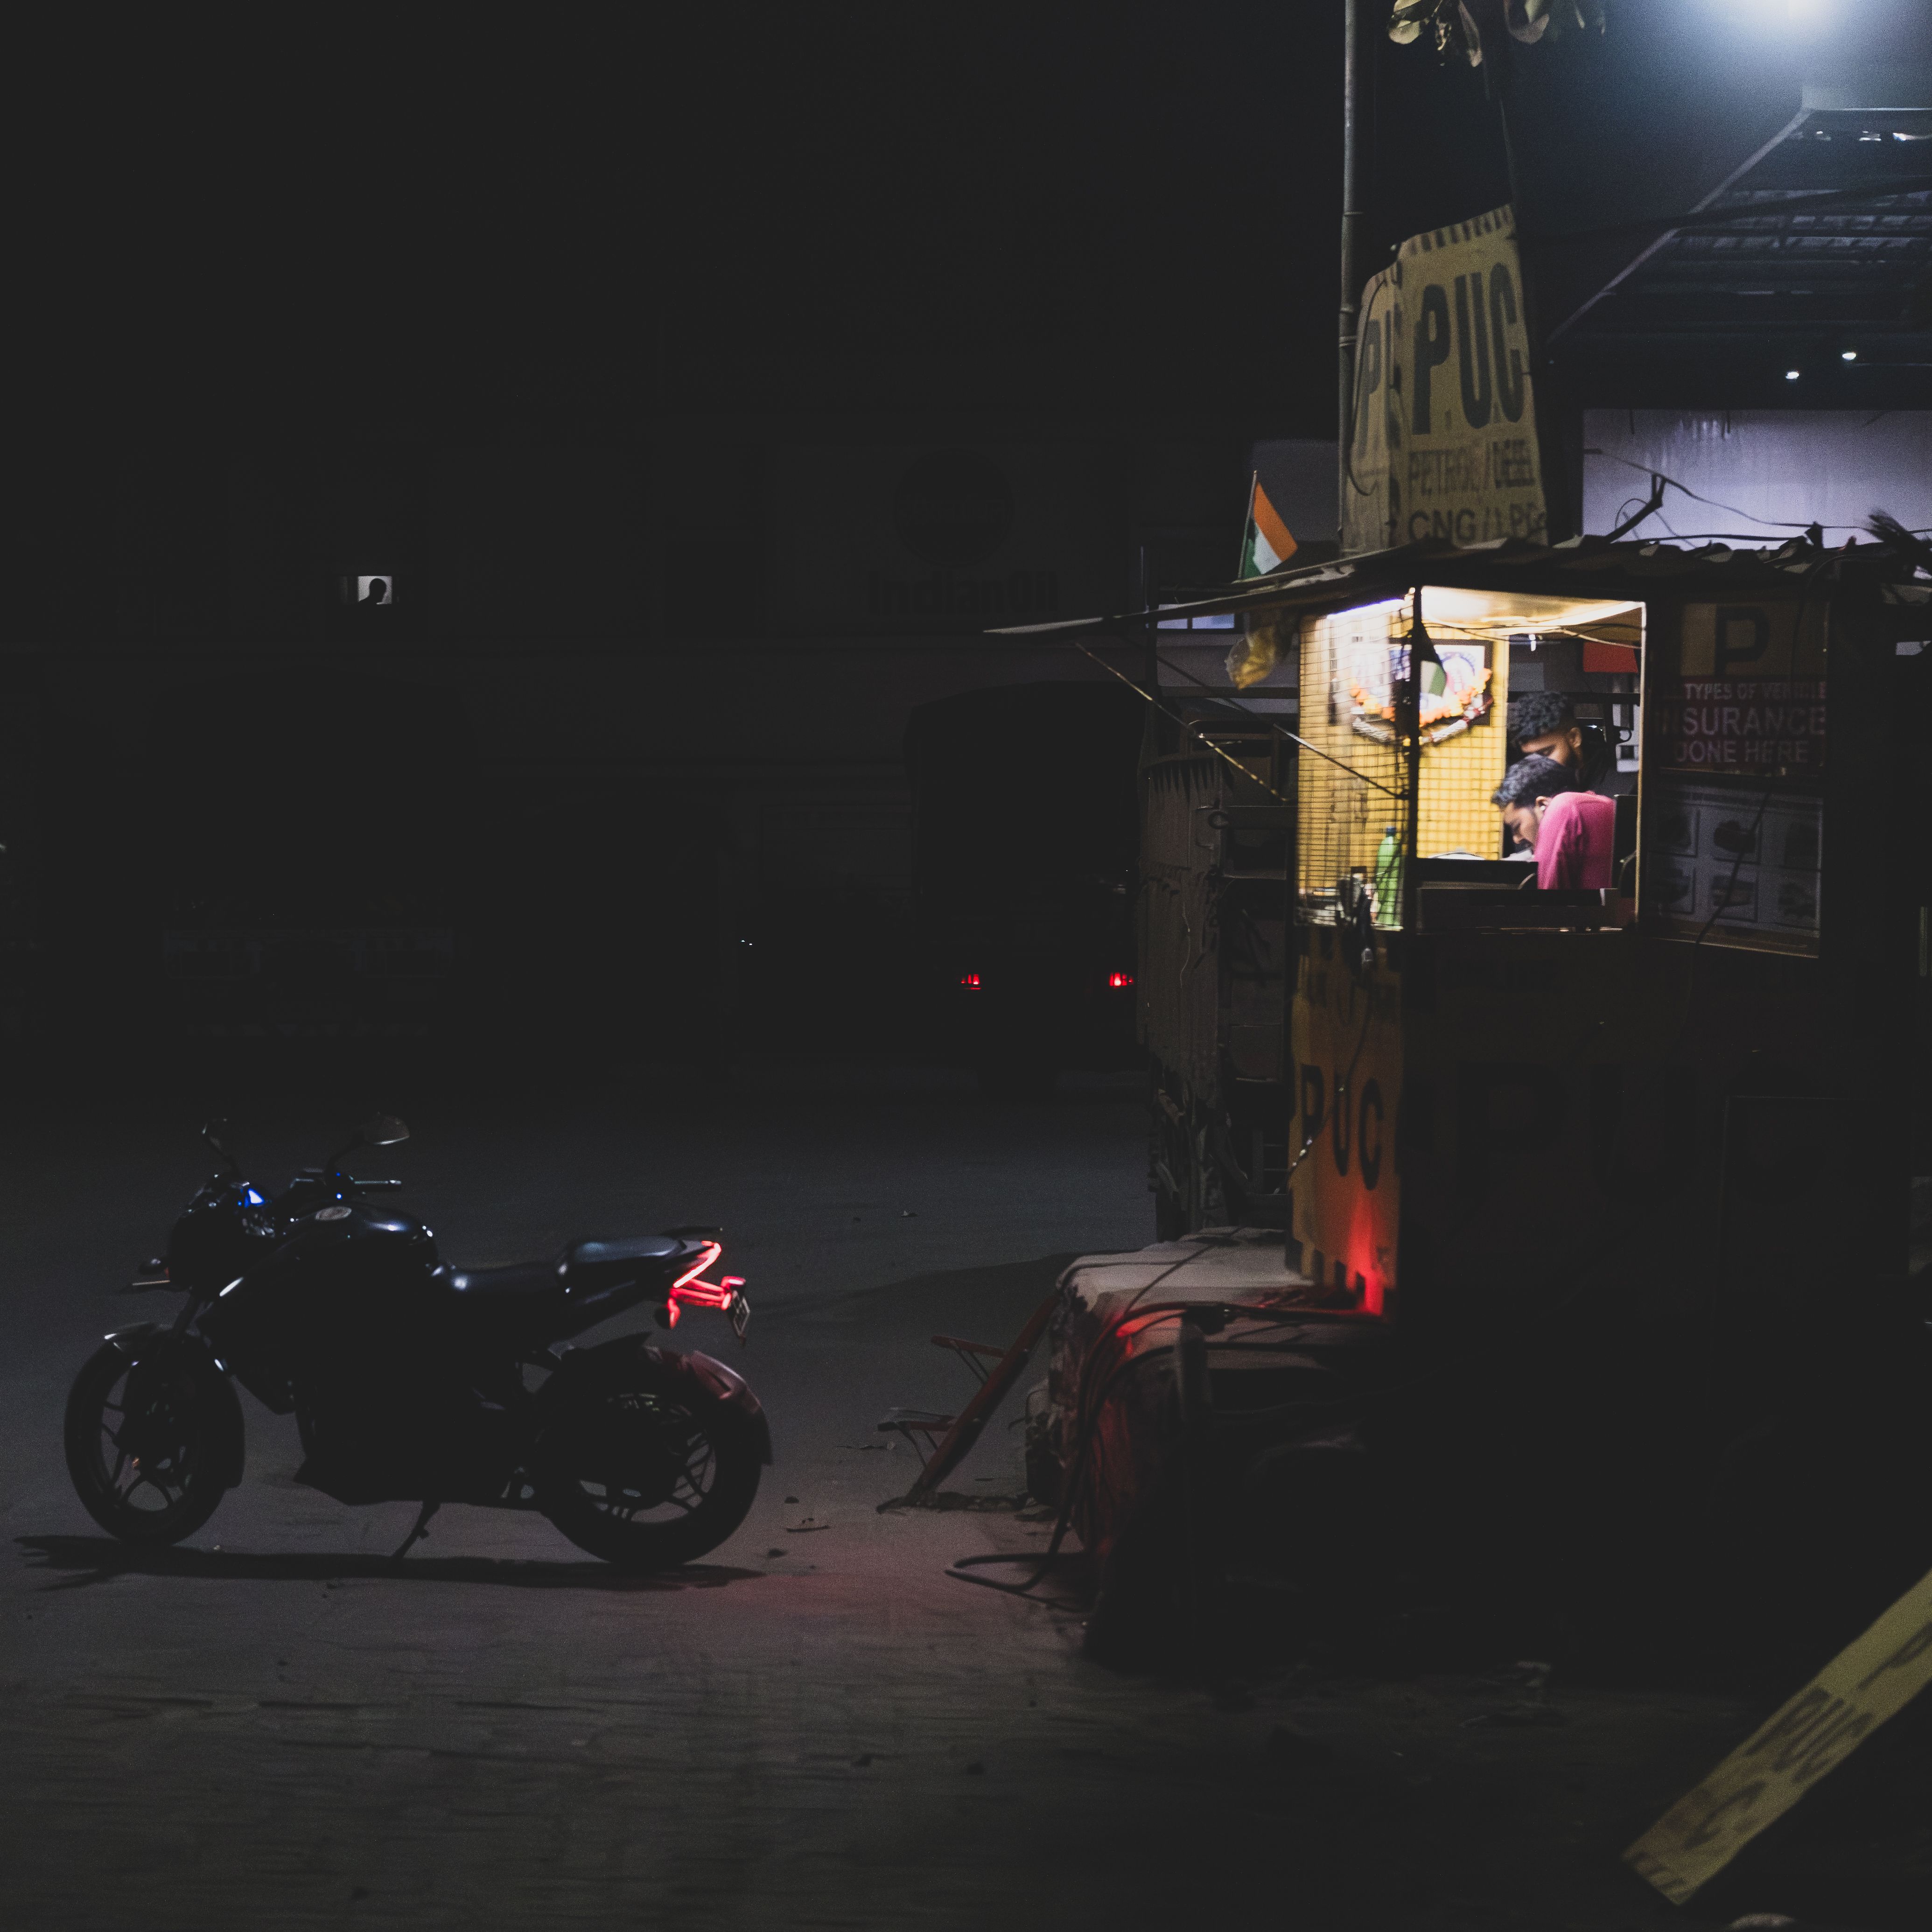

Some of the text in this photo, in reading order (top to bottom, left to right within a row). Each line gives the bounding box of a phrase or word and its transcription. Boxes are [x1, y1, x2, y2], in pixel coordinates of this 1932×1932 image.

[1412, 262, 1524, 434] PUC
[868, 570, 1058, 614] IndianOil
[1715, 608, 1770, 677] P
[1683, 683, 1732, 700] TYPES
[1736, 683, 1757, 700] OF
[1744, 740, 1809, 764] HERE
[1302, 1064, 1384, 1191] PUC
[1741, 1686, 1873, 1784] PUC
